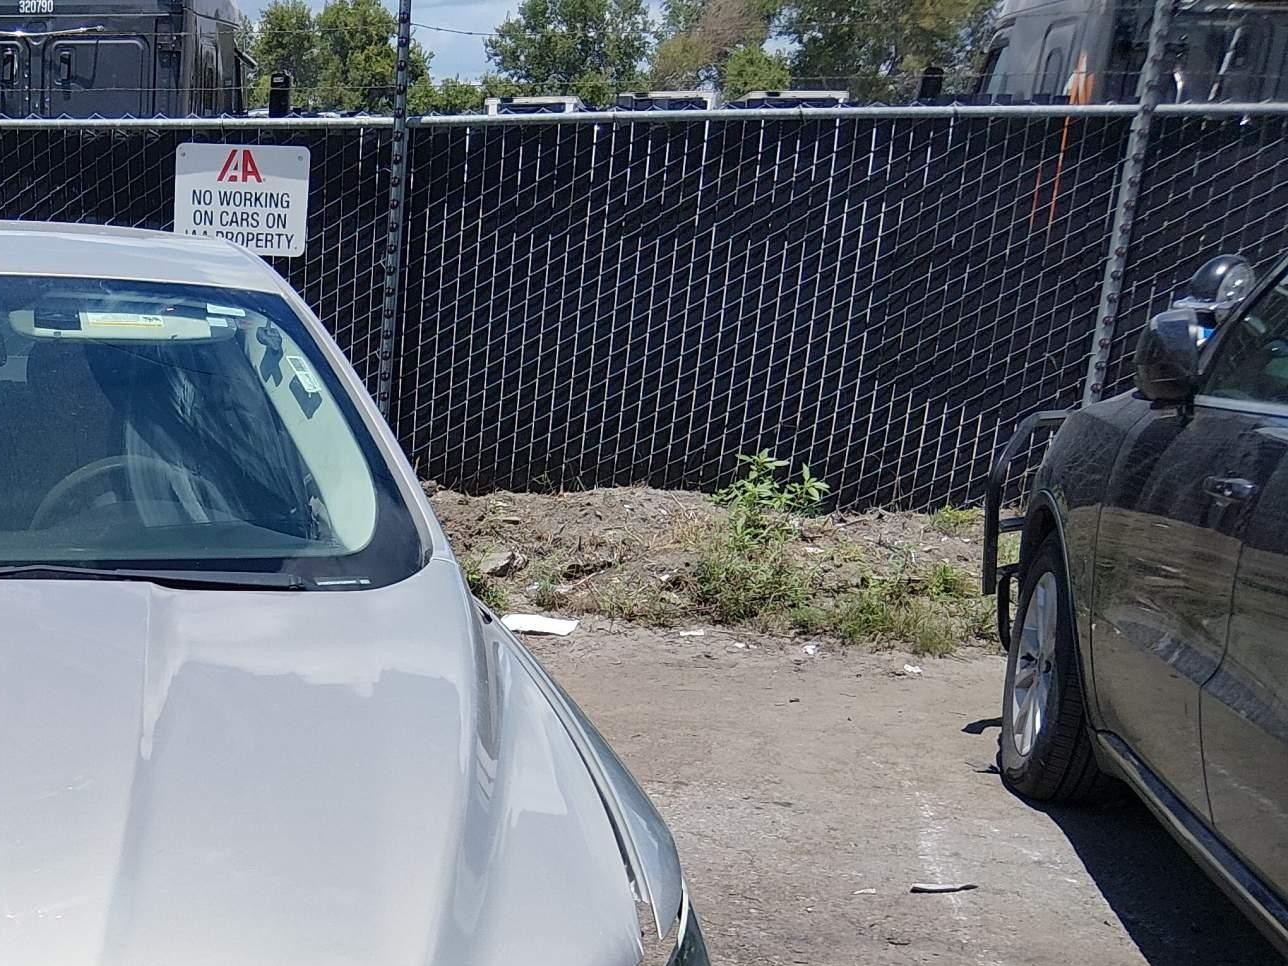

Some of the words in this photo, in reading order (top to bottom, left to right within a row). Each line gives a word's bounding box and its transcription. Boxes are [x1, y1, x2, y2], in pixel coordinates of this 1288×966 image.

[19, 0, 54, 13] 320790
[192, 189, 213, 206] NO
[218, 191, 290, 209] WORKING
[193, 209, 214, 226] ON
[219, 211, 260, 228] CARS
[265, 213, 287, 229] ON
